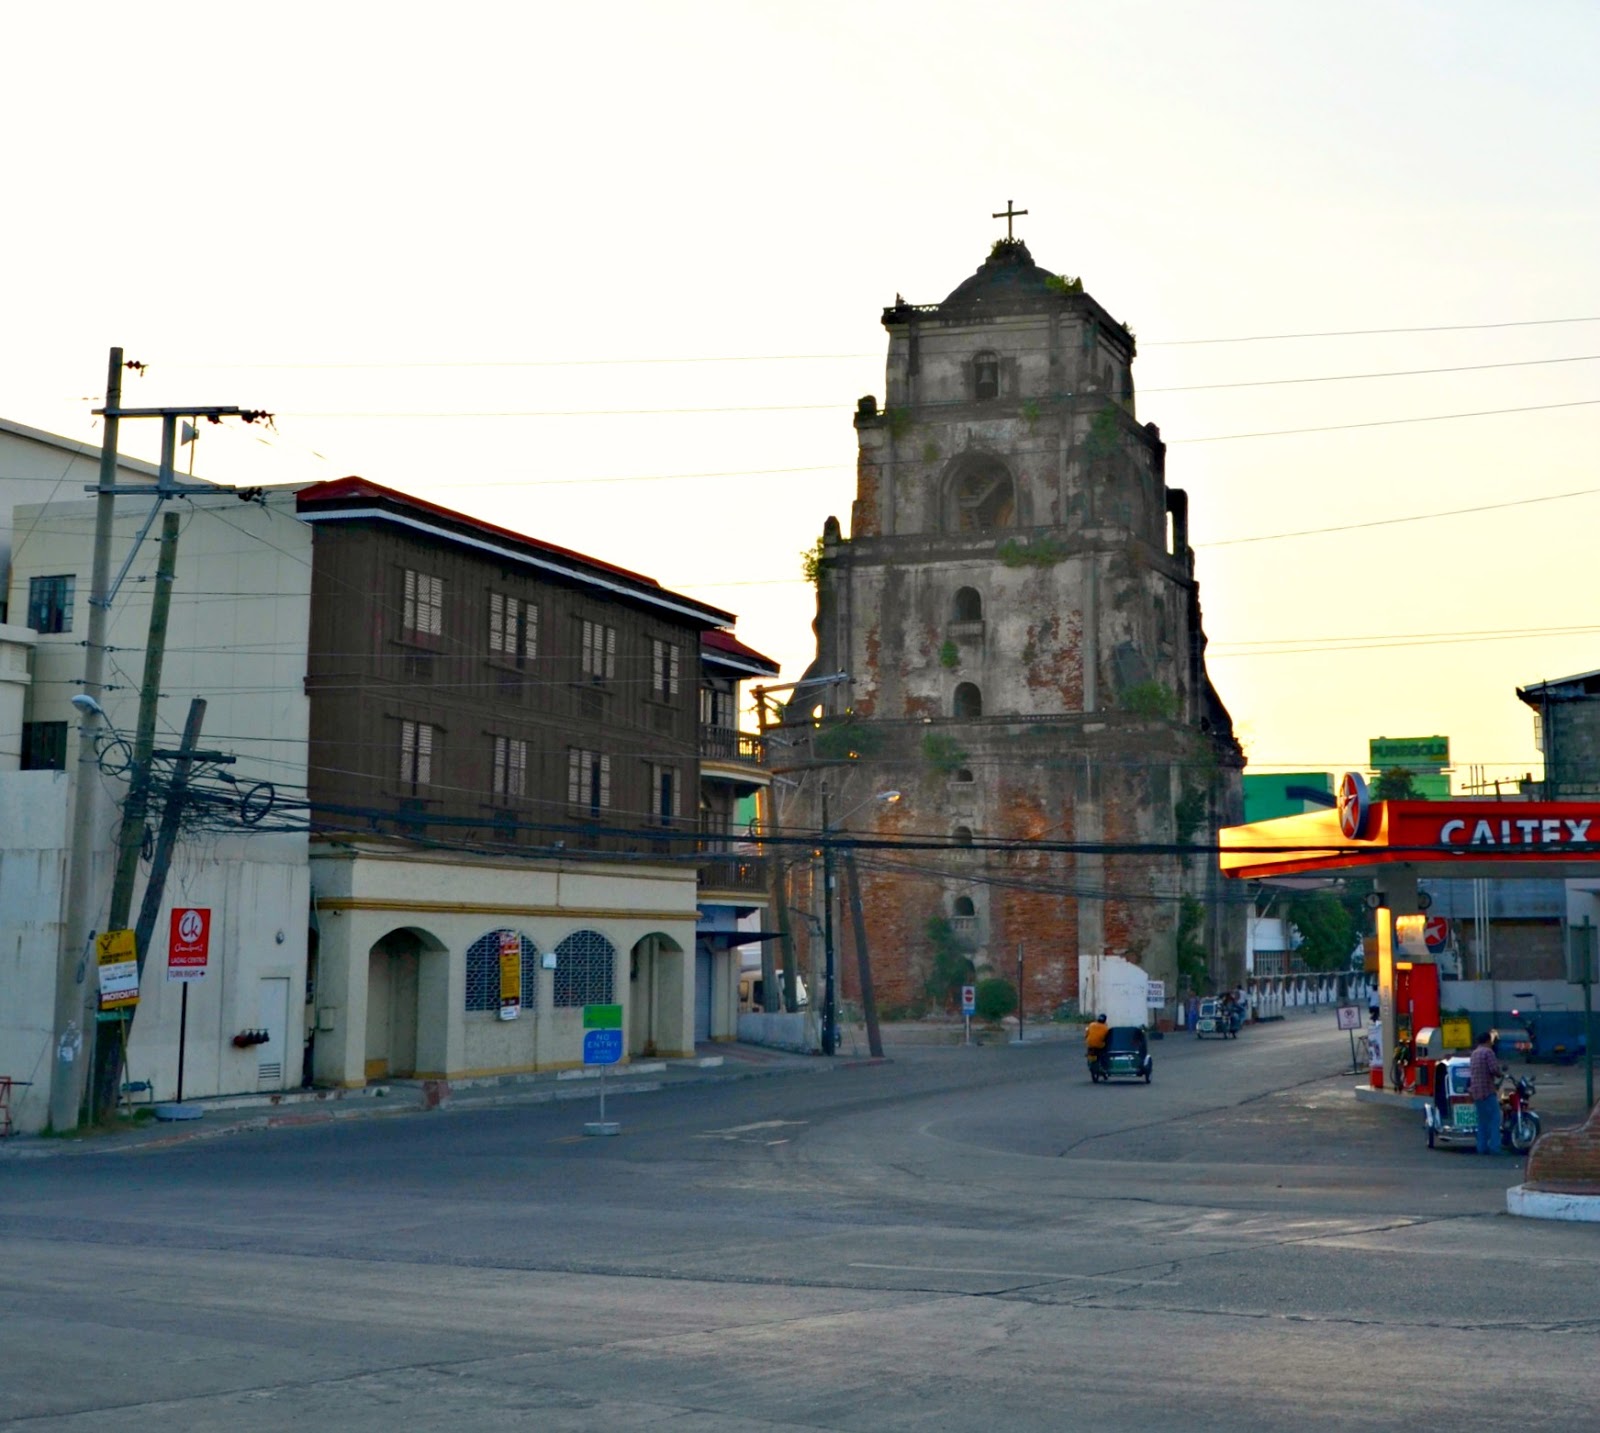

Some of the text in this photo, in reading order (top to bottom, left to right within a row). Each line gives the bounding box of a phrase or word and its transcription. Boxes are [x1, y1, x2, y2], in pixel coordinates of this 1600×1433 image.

[1440, 819, 1592, 853] CALTEX
[596, 1033, 610, 1041] NO
[587, 1040, 618, 1049] ENTRY
